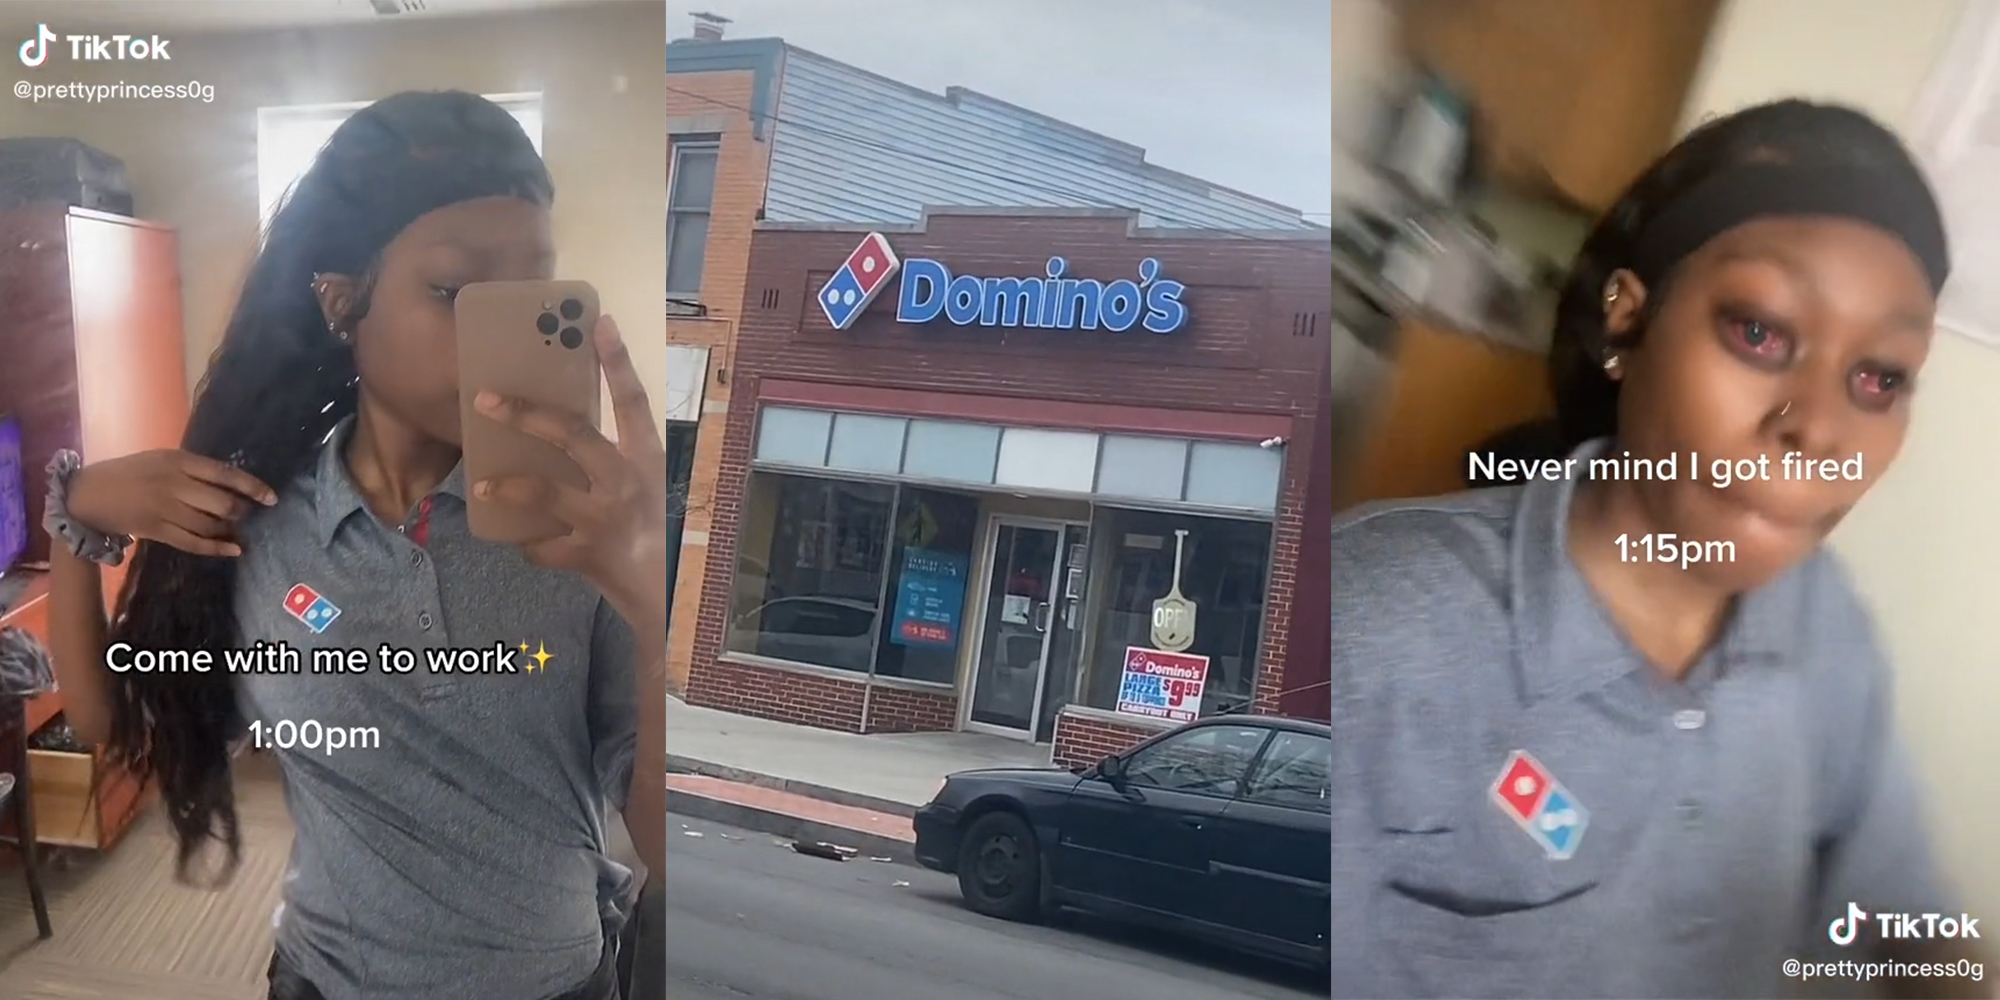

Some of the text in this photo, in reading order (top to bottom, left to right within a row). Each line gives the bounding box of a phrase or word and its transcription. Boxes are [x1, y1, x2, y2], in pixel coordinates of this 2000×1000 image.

[896, 256, 1188, 334] Domino's
[1145, 661, 1201, 679] Domino's
[1125, 673, 1162, 686] LARGE
[1122, 682, 1161, 696] PIZZA
